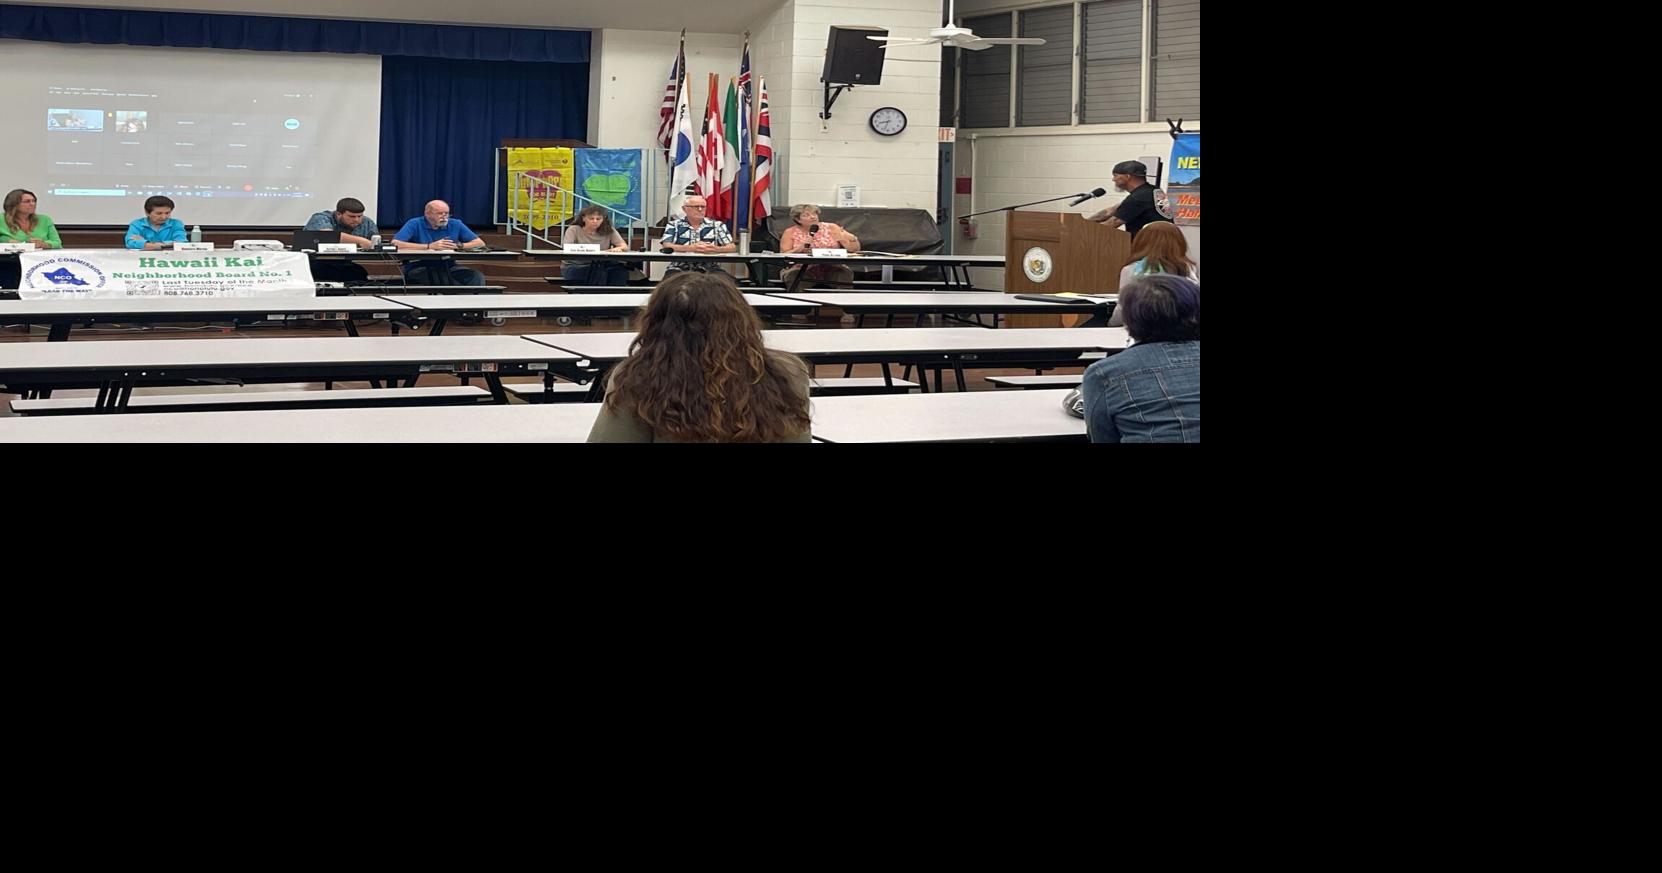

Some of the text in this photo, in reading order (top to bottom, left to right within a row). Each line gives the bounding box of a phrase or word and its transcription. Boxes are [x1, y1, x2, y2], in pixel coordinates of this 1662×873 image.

[939, 128, 951, 141] IT
[58, 257, 103, 275] COMMISSION
[139, 256, 263, 268] Hawaii Kai
[112, 272, 212, 280] Neighborhood
